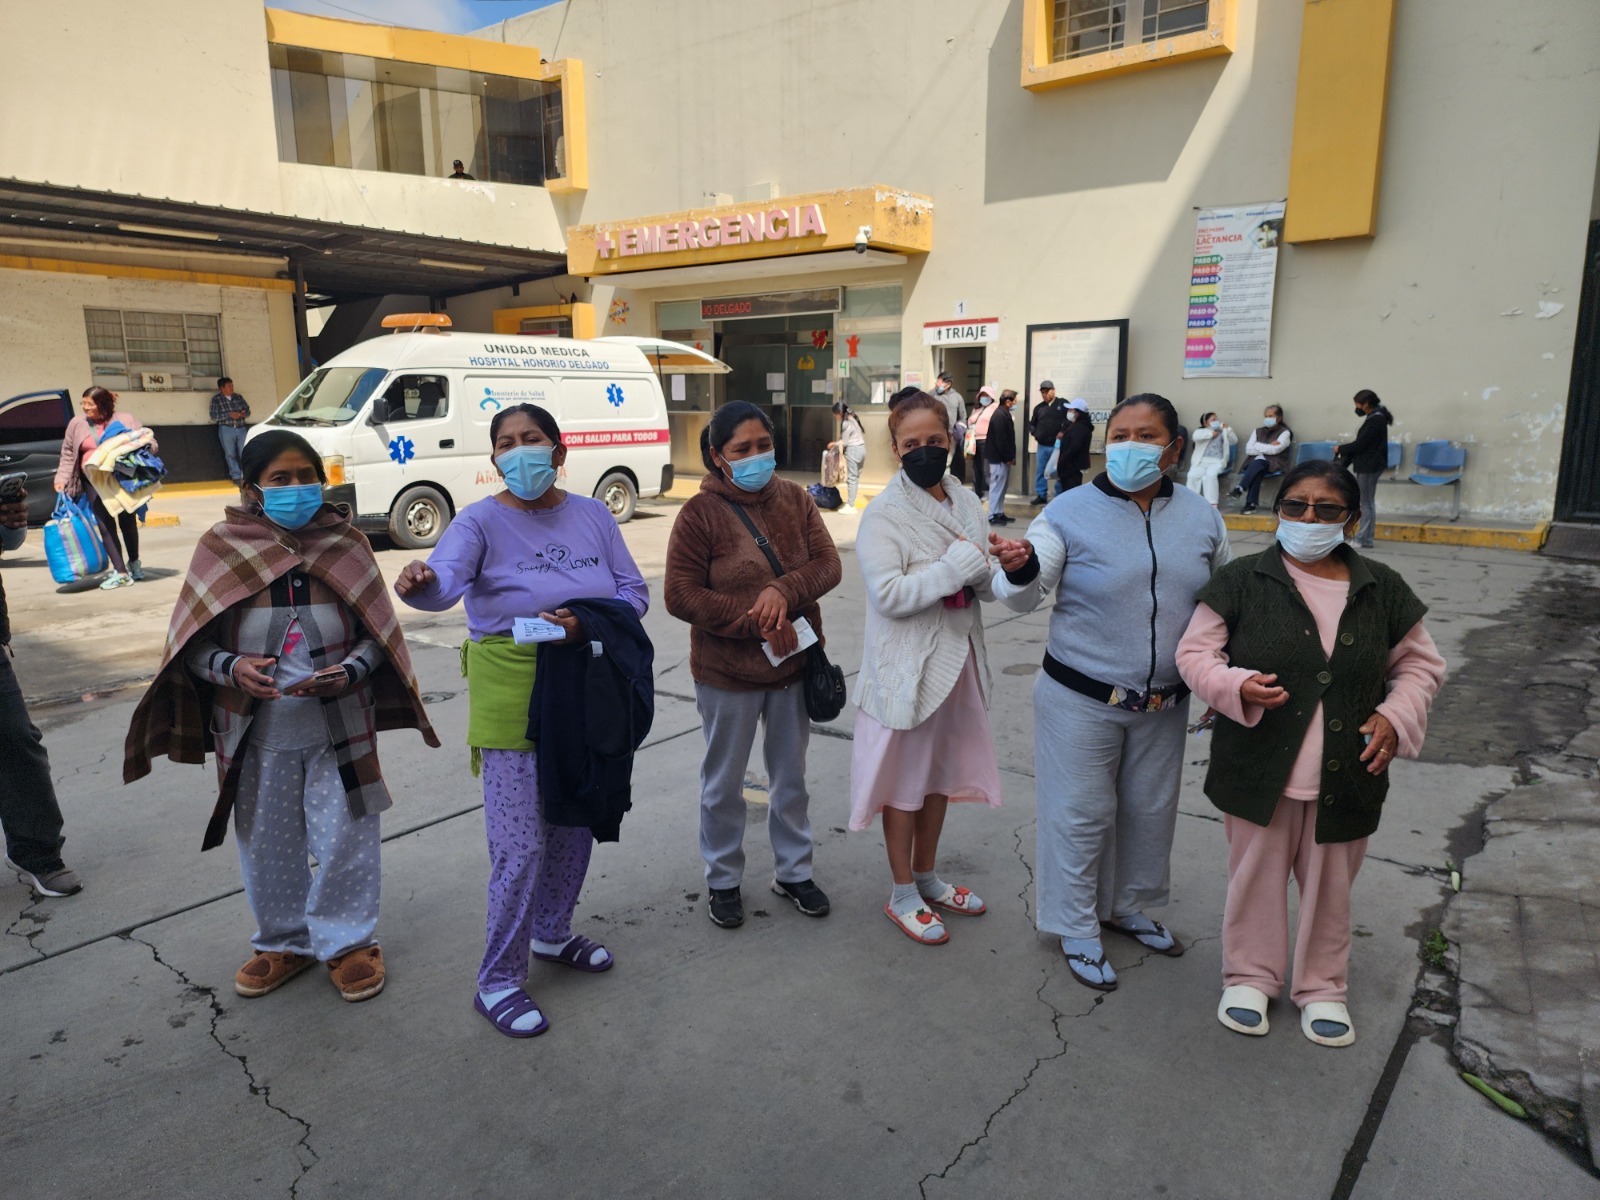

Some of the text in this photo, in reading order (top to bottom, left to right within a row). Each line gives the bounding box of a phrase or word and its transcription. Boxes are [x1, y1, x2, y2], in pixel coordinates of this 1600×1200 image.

[619, 203, 828, 256] EMERGENCIA
[1196, 234, 1243, 245] LACTANCIA
[1193, 266, 1210, 274] PASO
[1190, 296, 1207, 304] PASO
[713, 301, 752, 315] DELGADO
[958, 302, 964, 313] 1
[946, 326, 986, 340] TRIAJE
[484, 344, 590, 358] UNIDAD MEDICA
[1186, 344, 1203, 352] PASO
[469, 356, 609, 370] HOSPITAL HONORIO DELGADO
[840, 361, 847, 376] 4
[149, 375, 164, 384] NO
[565, 431, 658, 444] CON SALUD PARA TODOS
[569, 557, 593, 570] LOVE
